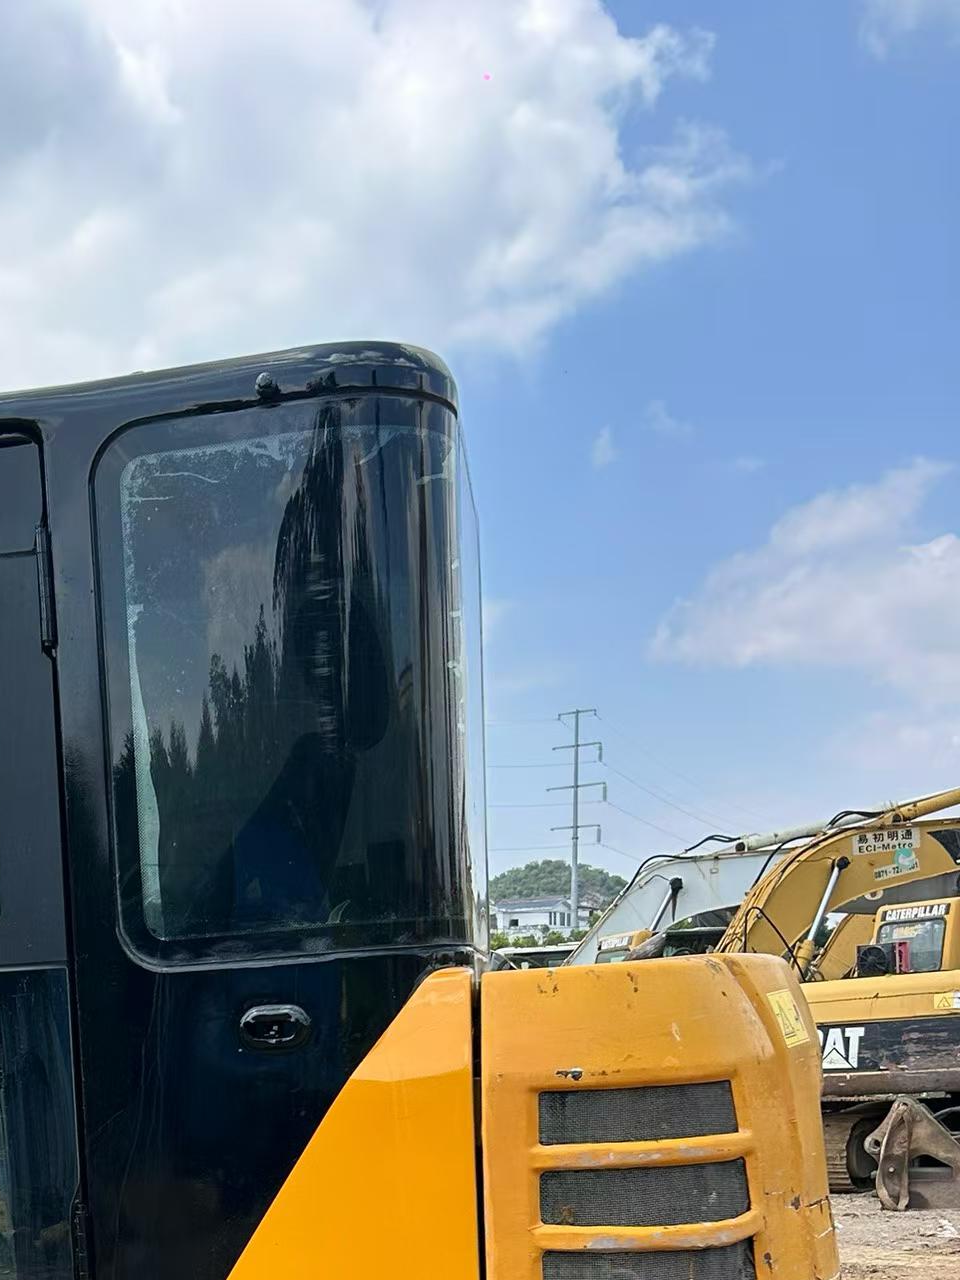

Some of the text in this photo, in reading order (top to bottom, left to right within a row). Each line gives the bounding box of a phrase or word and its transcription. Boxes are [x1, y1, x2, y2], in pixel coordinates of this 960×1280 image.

[857, 829, 913, 844] 易初明通
[858, 842, 913, 853] ECI-Metro
[885, 903, 946, 920] CATERPILLAR
